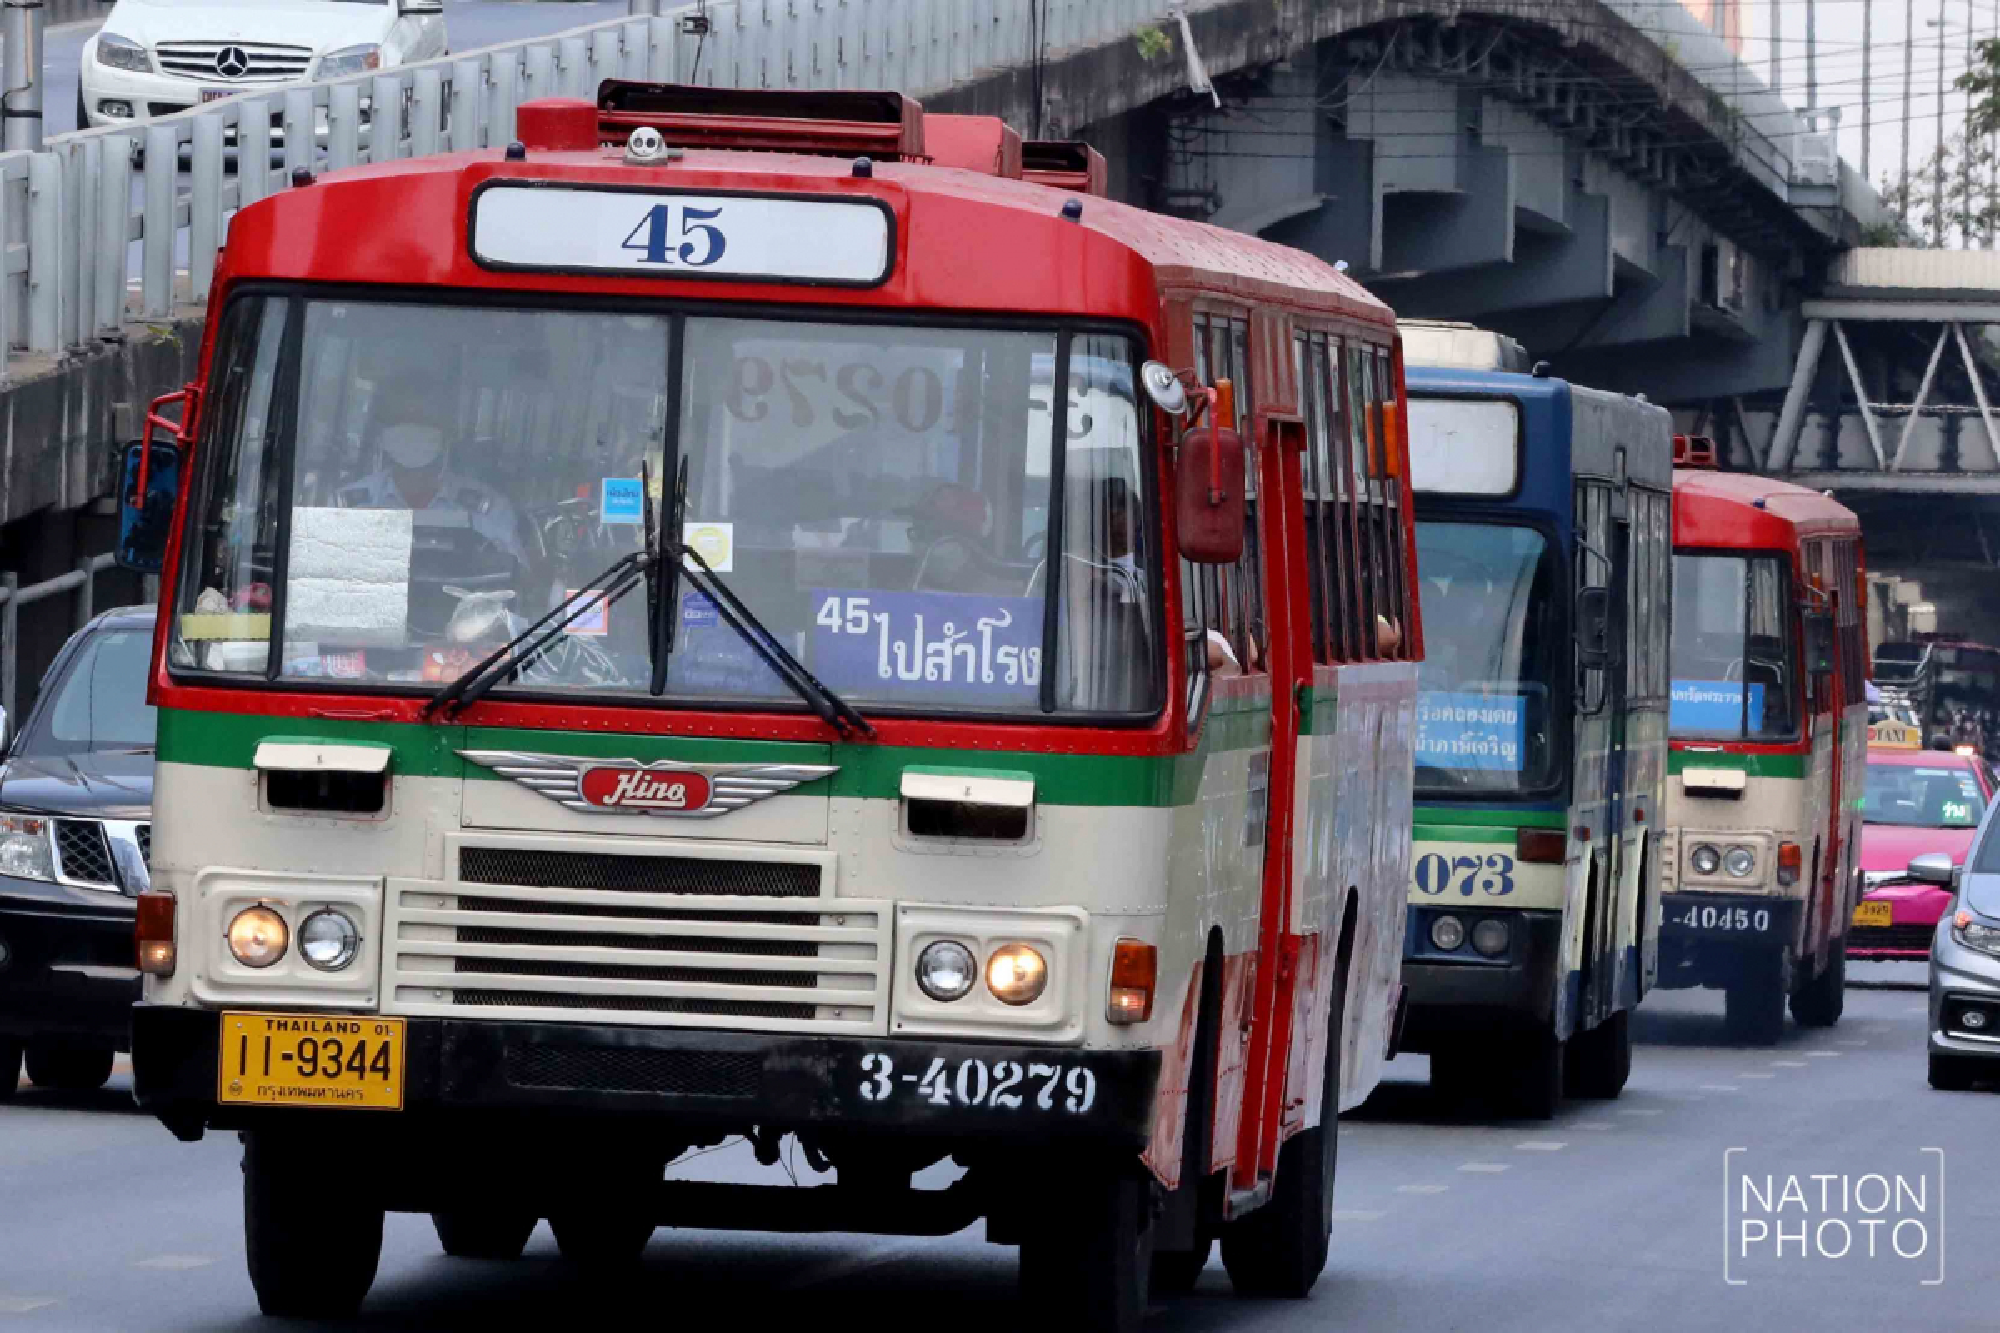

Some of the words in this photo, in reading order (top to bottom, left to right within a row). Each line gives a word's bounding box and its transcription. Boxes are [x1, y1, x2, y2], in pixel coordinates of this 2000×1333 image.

[620, 203, 727, 267] 45
[816, 597, 870, 634] 45
[873, 607, 1043, 686] ไปสำโรง
[1876, 729, 1906, 742] TAXI
[602, 770, 686, 807] Hino
[1409, 852, 1514, 896] 073
[265, 1019, 361, 1034] THAILAND
[239, 1034, 391, 1081] 11-9344
[257, 1085, 364, 1101] กรุงเทพมหานคร
[860, 1052, 1097, 1113] 3-40279
